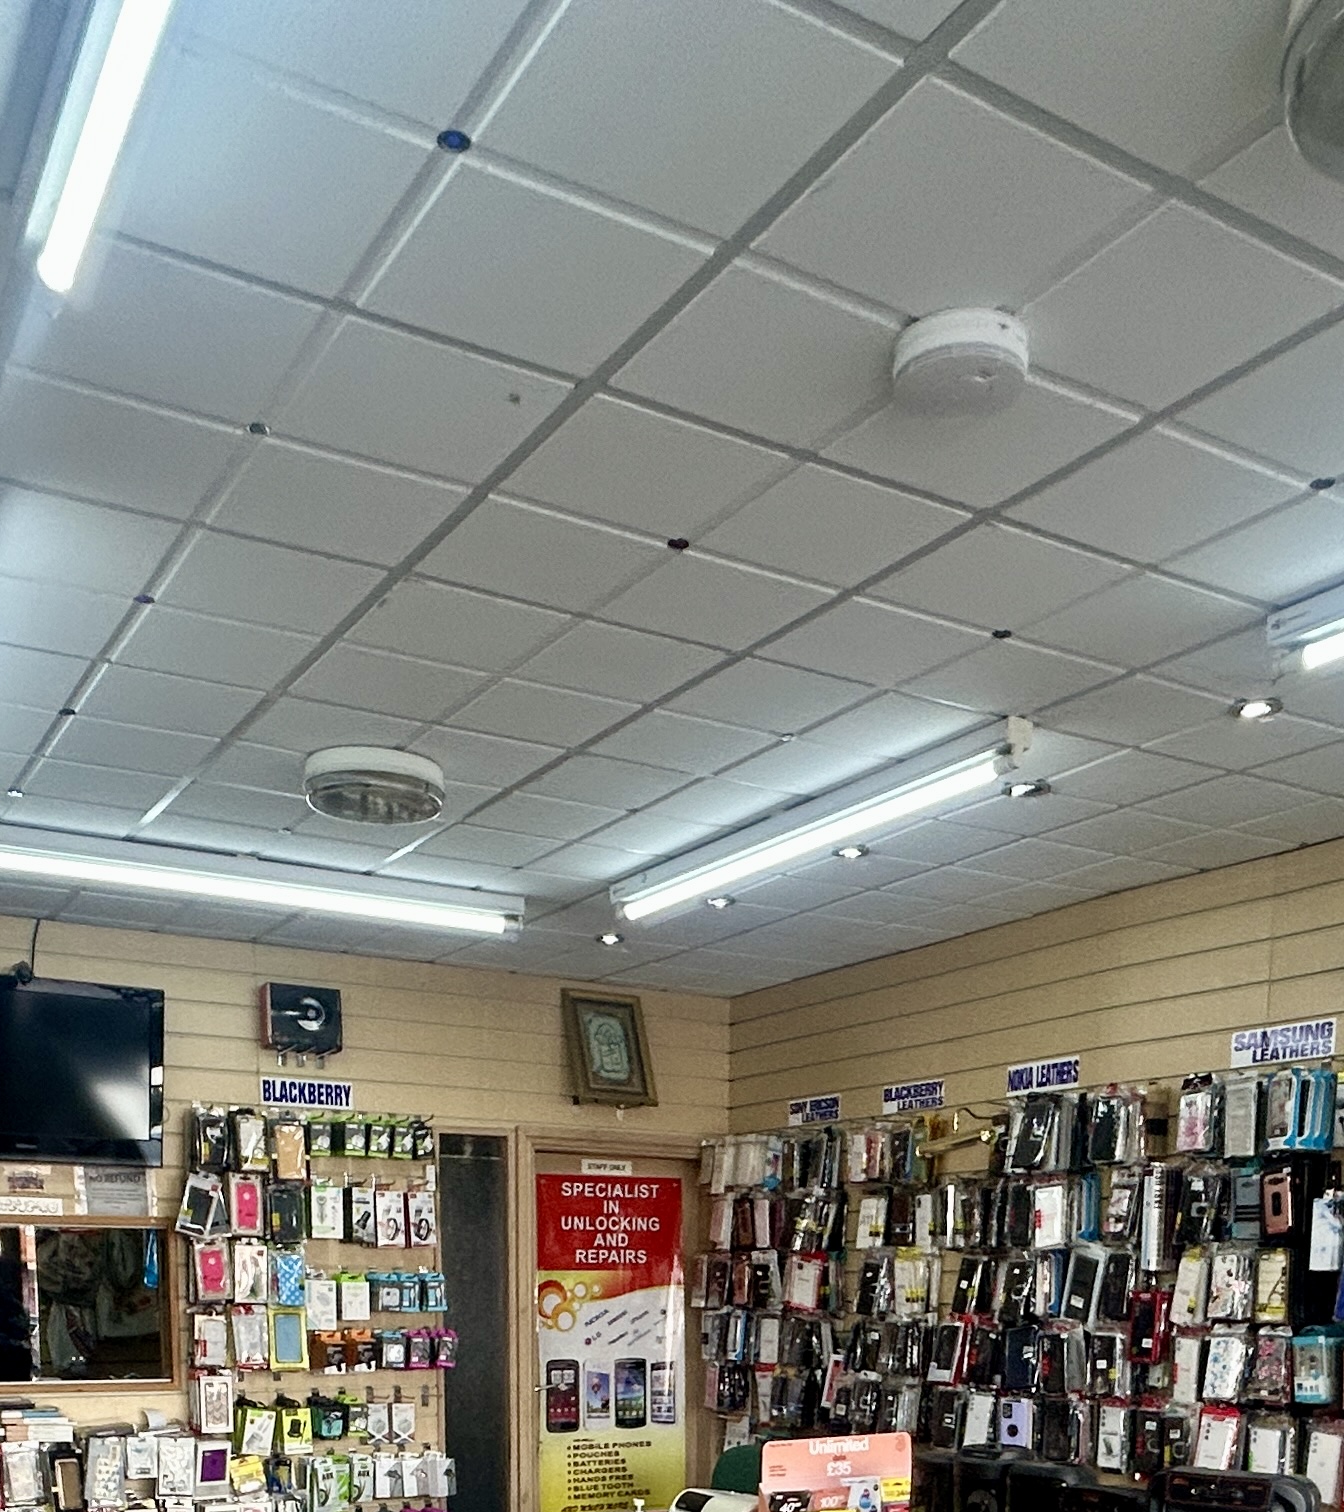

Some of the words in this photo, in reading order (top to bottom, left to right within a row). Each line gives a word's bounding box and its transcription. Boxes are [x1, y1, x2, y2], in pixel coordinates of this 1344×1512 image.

[1234, 1021, 1334, 1052] SAMSUNG
[1252, 1039, 1333, 1064] LEATHERS
[1037, 1059, 1079, 1087] LEATHERS
[263, 1079, 351, 1107] BLACKBERRY
[884, 1080, 944, 1102] BLACKBERRY
[790, 1101, 807, 1115] SONY
[897, 1096, 943, 1110] LEATHERS
[802, 1109, 839, 1123] LEATHERS
[561, 1182, 659, 1198] SPECIALIST
[603, 1200, 619, 1214] IN
[561, 1216, 660, 1231] UNLOCKING
[594, 1233, 629, 1247] AND
[575, 1249, 647, 1264] REPAIRS
[809, 1437, 870, 1455] Unlimited
[573, 1459, 626, 1467] BATTERIES
[827, 1461, 852, 1476] £35
[322, 1471, 334, 1480] AUX
[357, 1470, 370, 1478] AUX
[573, 1466, 628, 1475] CHARGERS
[573, 1484, 599, 1492] BLUE
[602, 1482, 634, 1490] TOOTH
[573, 1491, 615, 1499] MEMORY
